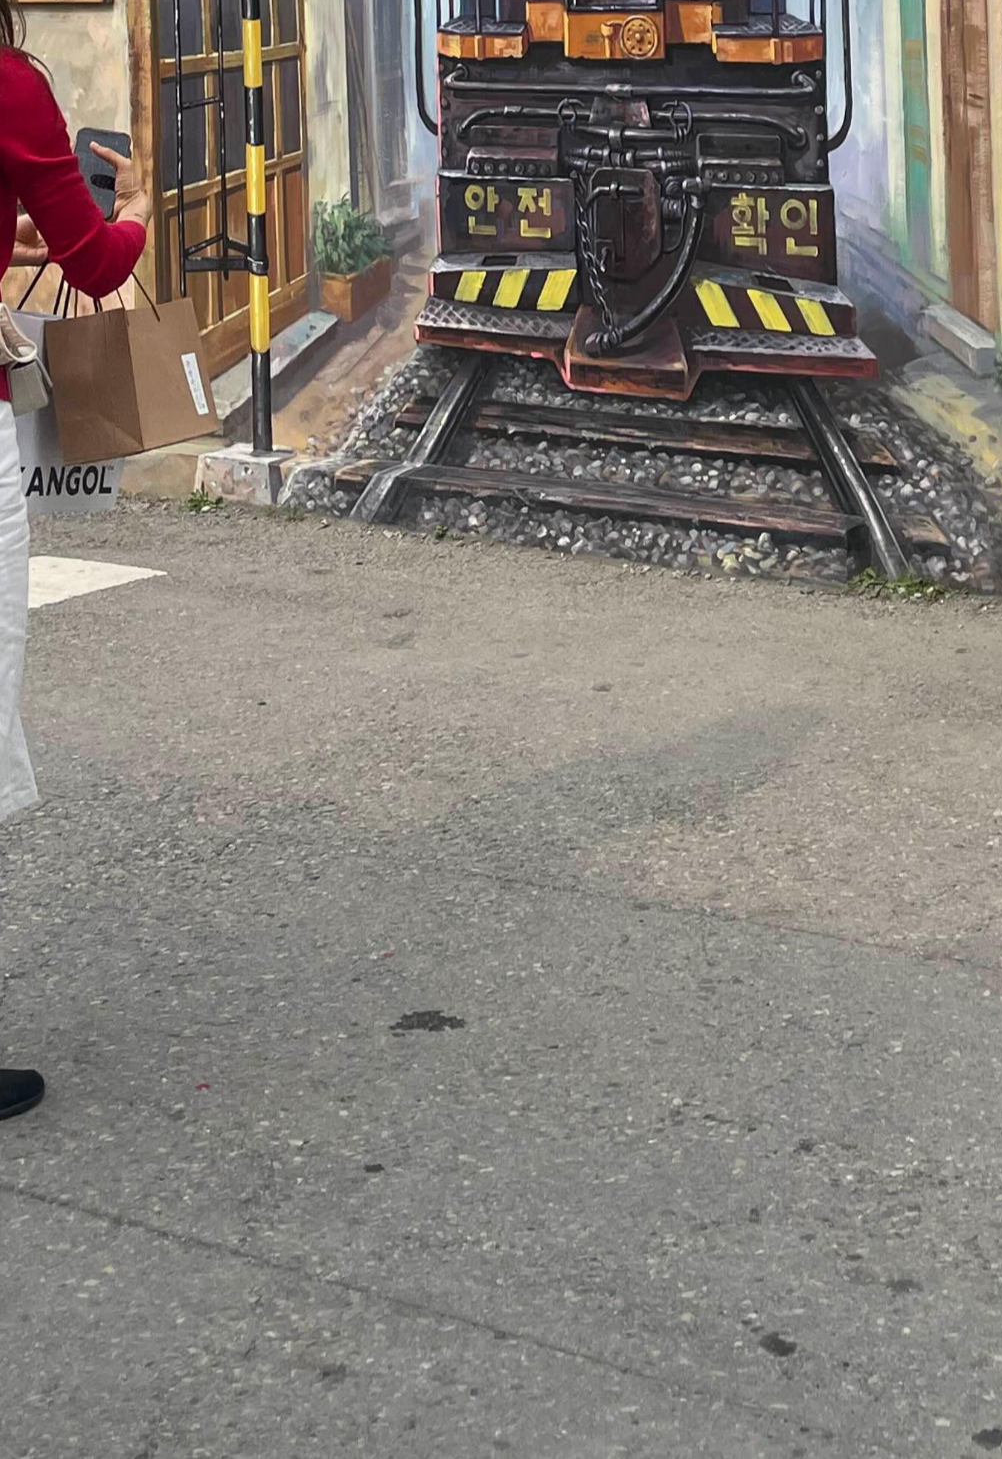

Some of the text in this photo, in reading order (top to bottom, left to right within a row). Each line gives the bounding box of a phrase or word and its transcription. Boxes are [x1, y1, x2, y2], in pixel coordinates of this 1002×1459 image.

[464, 184, 552, 239] 안전
[730, 192, 819, 257] 확인
[20, 465, 112, 498] ANGOL
